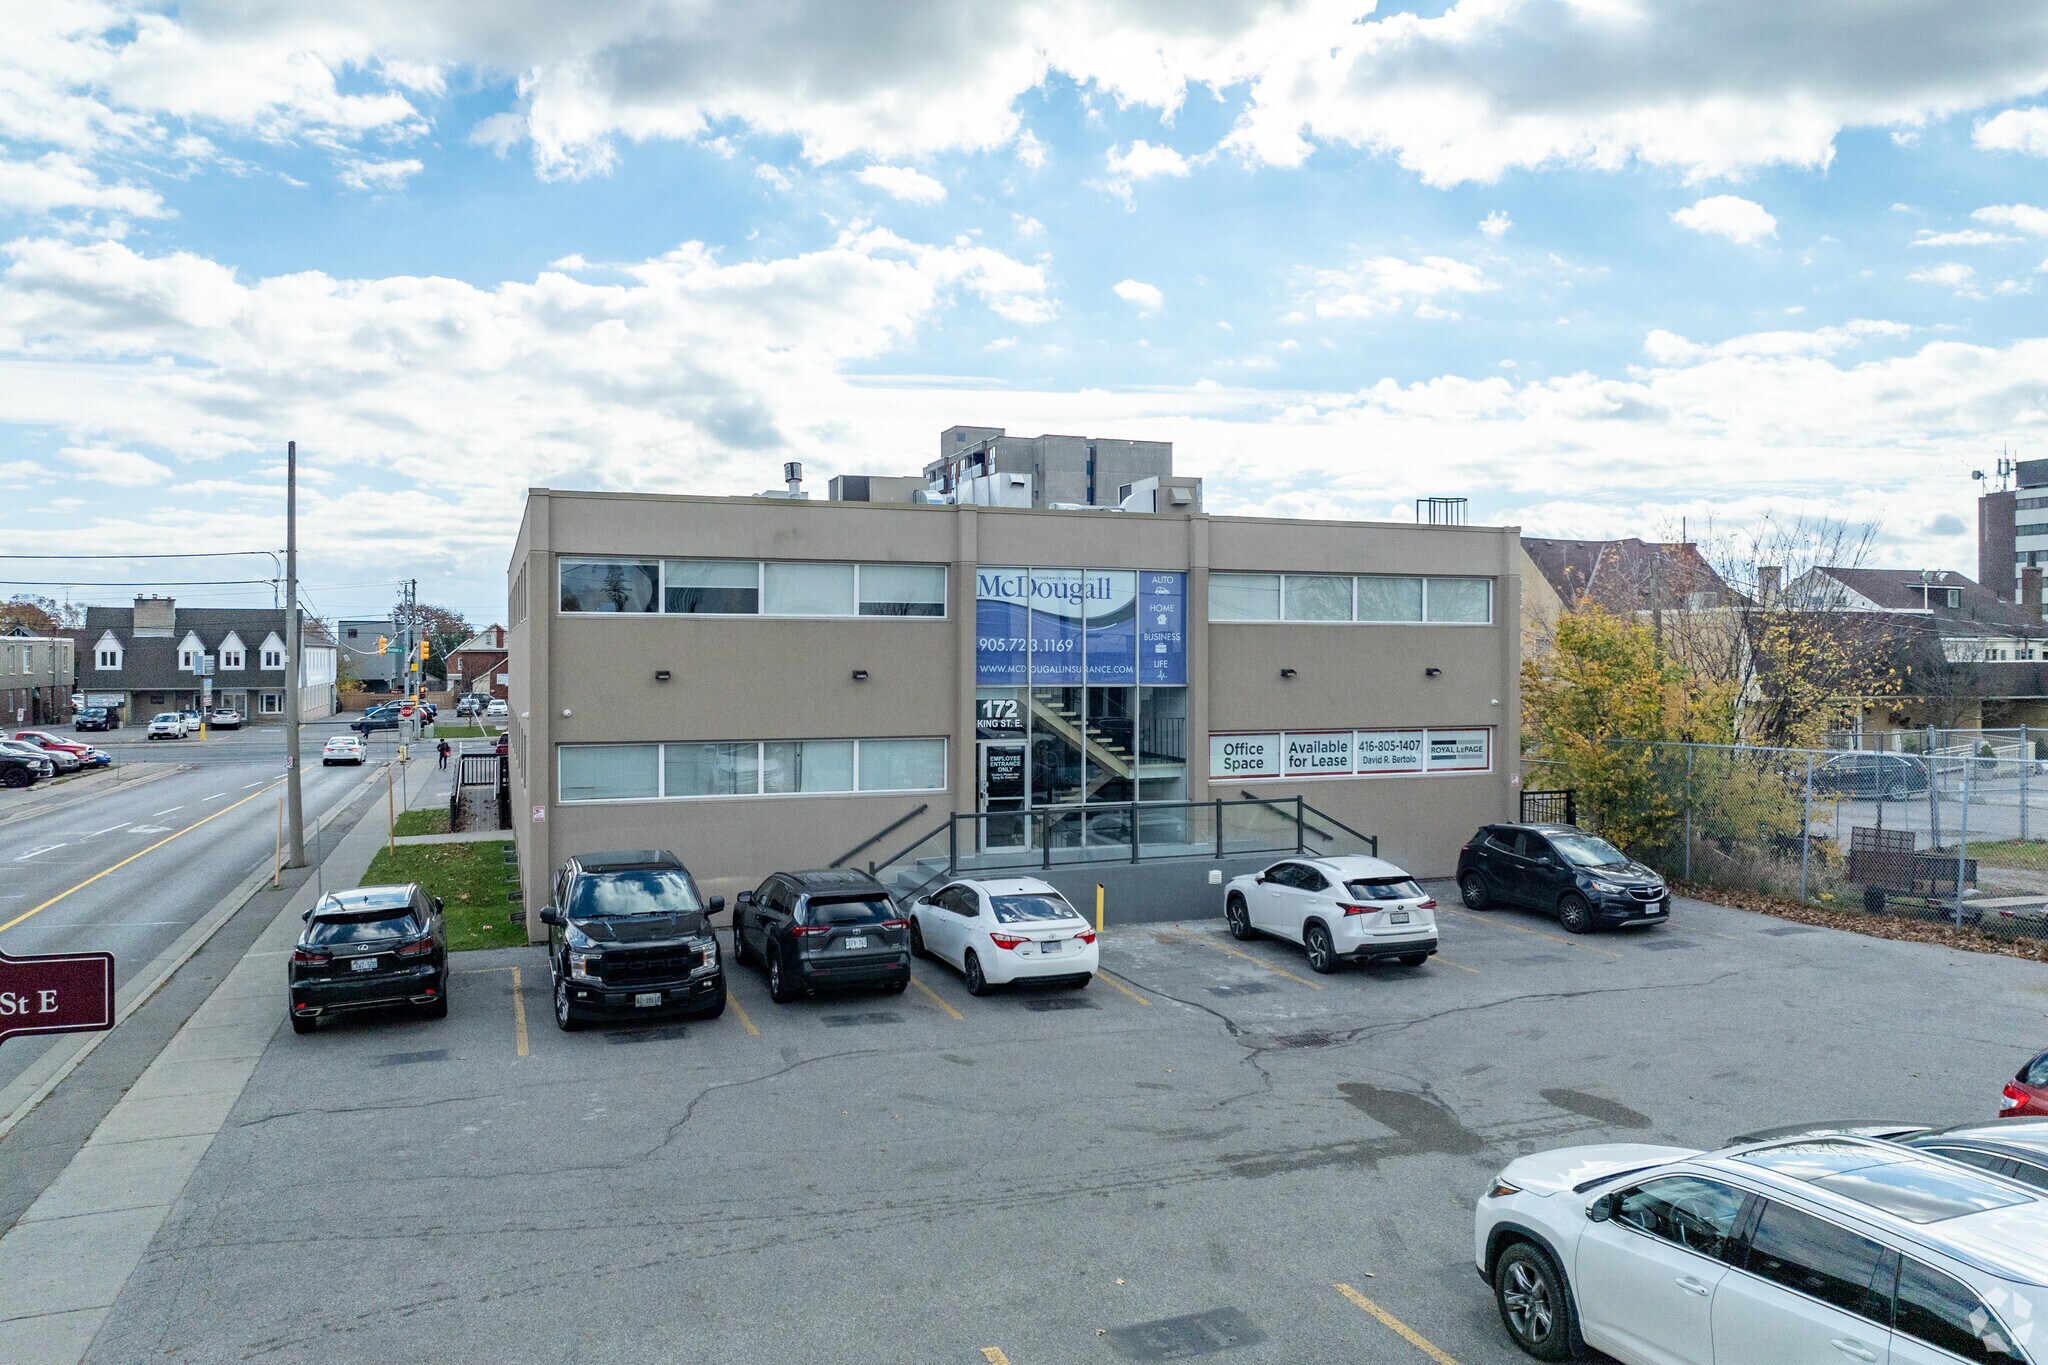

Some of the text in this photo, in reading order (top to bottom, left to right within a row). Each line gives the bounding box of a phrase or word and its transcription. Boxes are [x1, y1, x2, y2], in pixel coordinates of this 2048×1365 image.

[1151, 575, 1174, 584] AUTO
[977, 574, 1112, 605] McDougall
[1149, 604, 1175, 613] HOME
[1144, 632, 1181, 641] BUSINESS
[979, 638, 1074, 653] 905.723.1169
[979, 665, 1134, 674] WWW.MCDOUGALLINSURANCE.COM
[1153, 659, 1168, 668] LIFE
[982, 700, 1018, 718] 172
[977, 719, 1023, 728] KING ST. E.
[1224, 742, 1264, 756] Office
[1288, 740, 1348, 754] Available
[1358, 740, 1421, 752] 416-805-1407
[1430, 746, 1455, 754] ROYAL
[1224, 757, 1264, 772] Space
[1288, 755, 1348, 768] for Lease
[1362, 754, 1417, 765] David R. Bertolo
[0, 990, 59, 1016] St E
